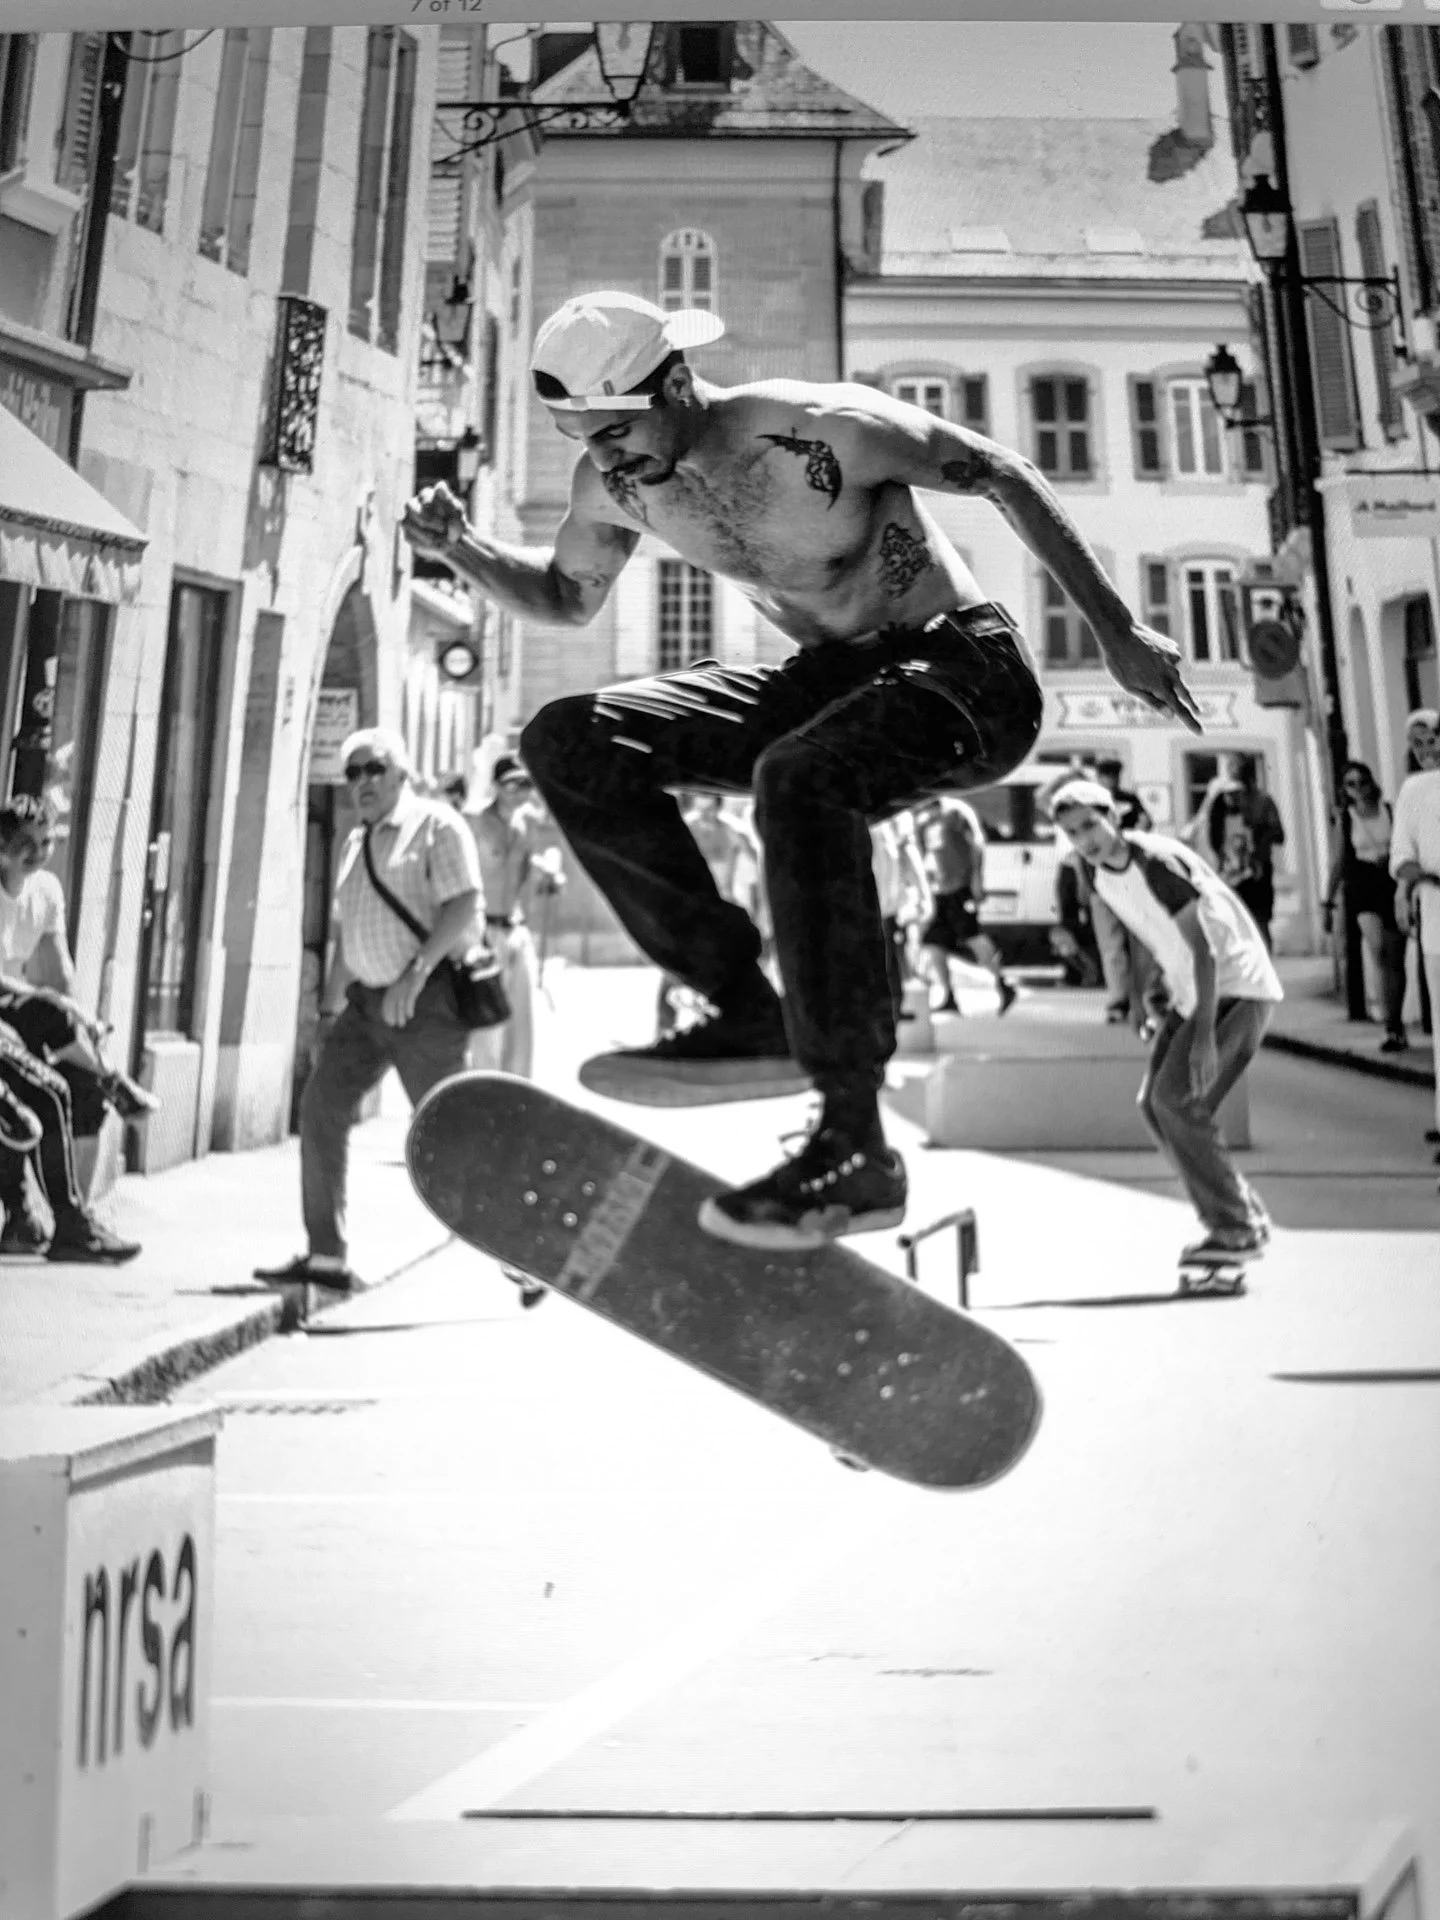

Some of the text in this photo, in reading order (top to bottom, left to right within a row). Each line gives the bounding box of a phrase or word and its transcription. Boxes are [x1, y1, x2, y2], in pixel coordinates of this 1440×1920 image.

[429, 0, 451, 12] of
[458, 0, 482, 12] 12
[79, 1533, 197, 1768] nrsa
